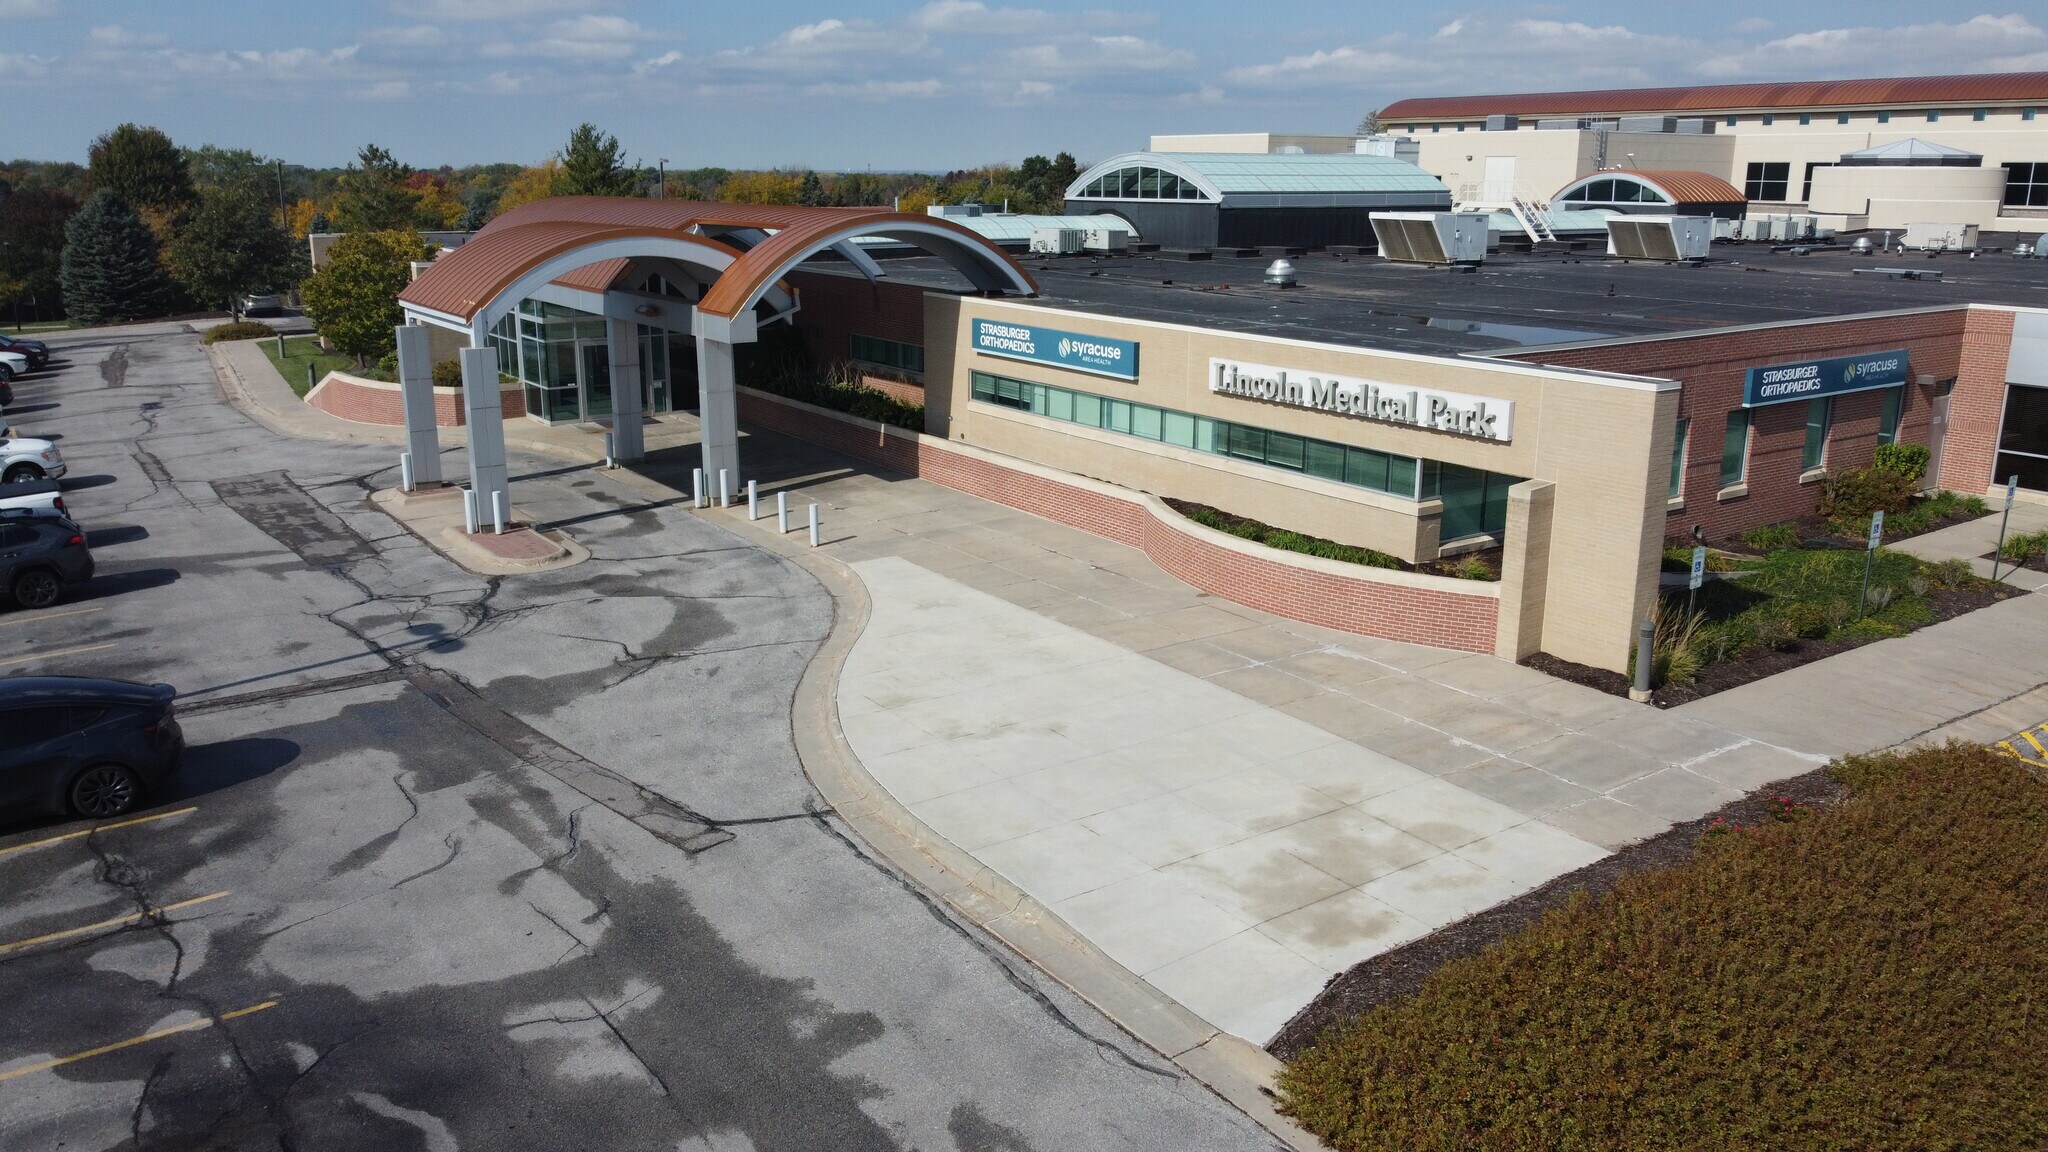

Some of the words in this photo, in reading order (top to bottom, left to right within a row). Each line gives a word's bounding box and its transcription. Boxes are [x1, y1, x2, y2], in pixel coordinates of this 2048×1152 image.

[980, 323, 1030, 341] STRASBURGER
[980, 335, 1035, 355] ORTHOPAEDICS
[1071, 340, 1121, 360] syracuse
[1094, 358, 1112, 366] HEALTH
[1856, 358, 1898, 377] syracuse
[1763, 365, 1818, 384] STRASBURGER
[1760, 378, 1821, 397] ORTHOPAEDICS
[1213, 362, 1304, 404] Lincoln
[1308, 376, 1418, 425] Medical
[1424, 394, 1497, 438] Park
